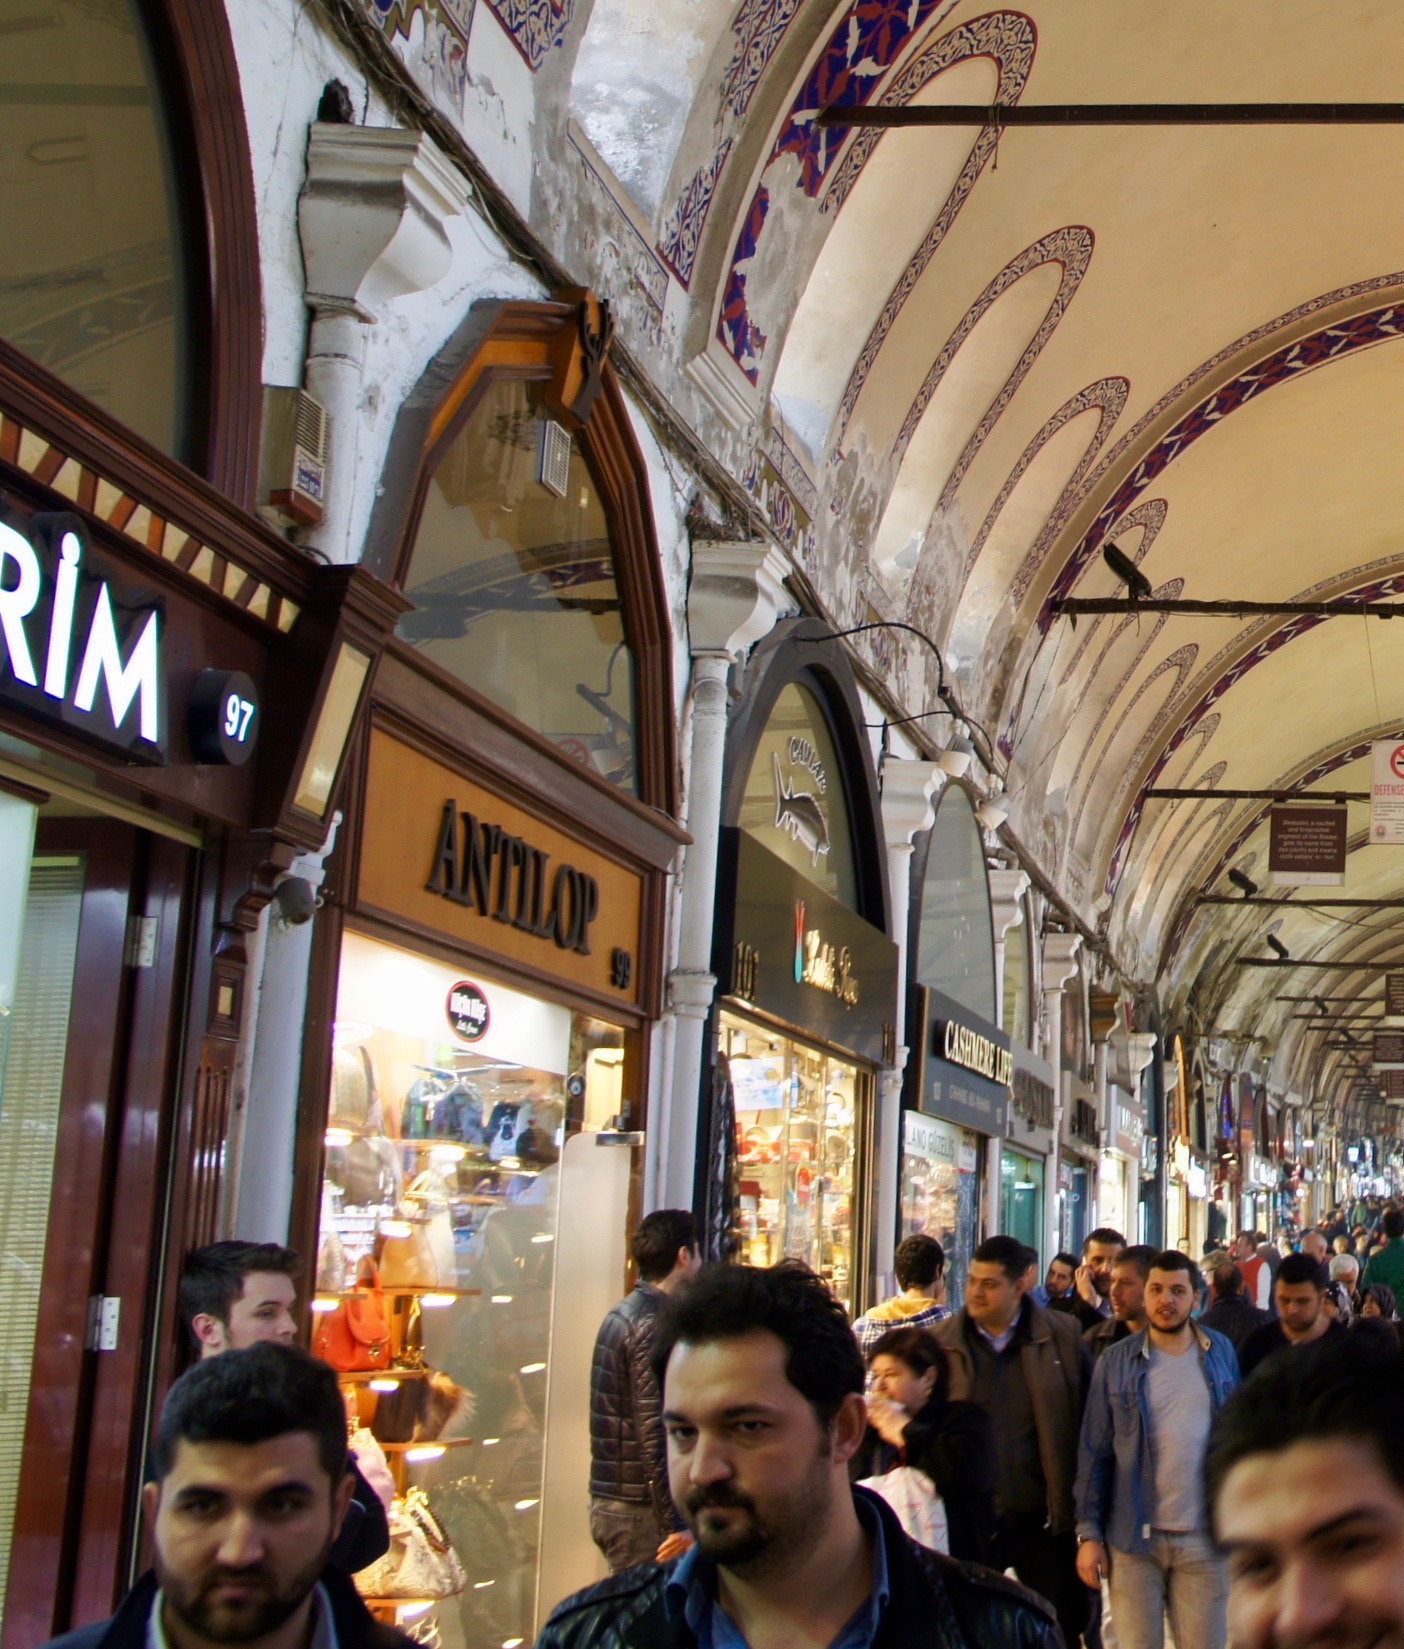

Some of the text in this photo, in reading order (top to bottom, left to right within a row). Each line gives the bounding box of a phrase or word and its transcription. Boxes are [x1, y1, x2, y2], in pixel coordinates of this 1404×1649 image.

[224, 693, 255, 742] 97
[1374, 784, 1404, 796] DEFENSE
[944, 1019, 995, 1079] CASHMERE
[996, 1045, 1014, 1086] LIFE
